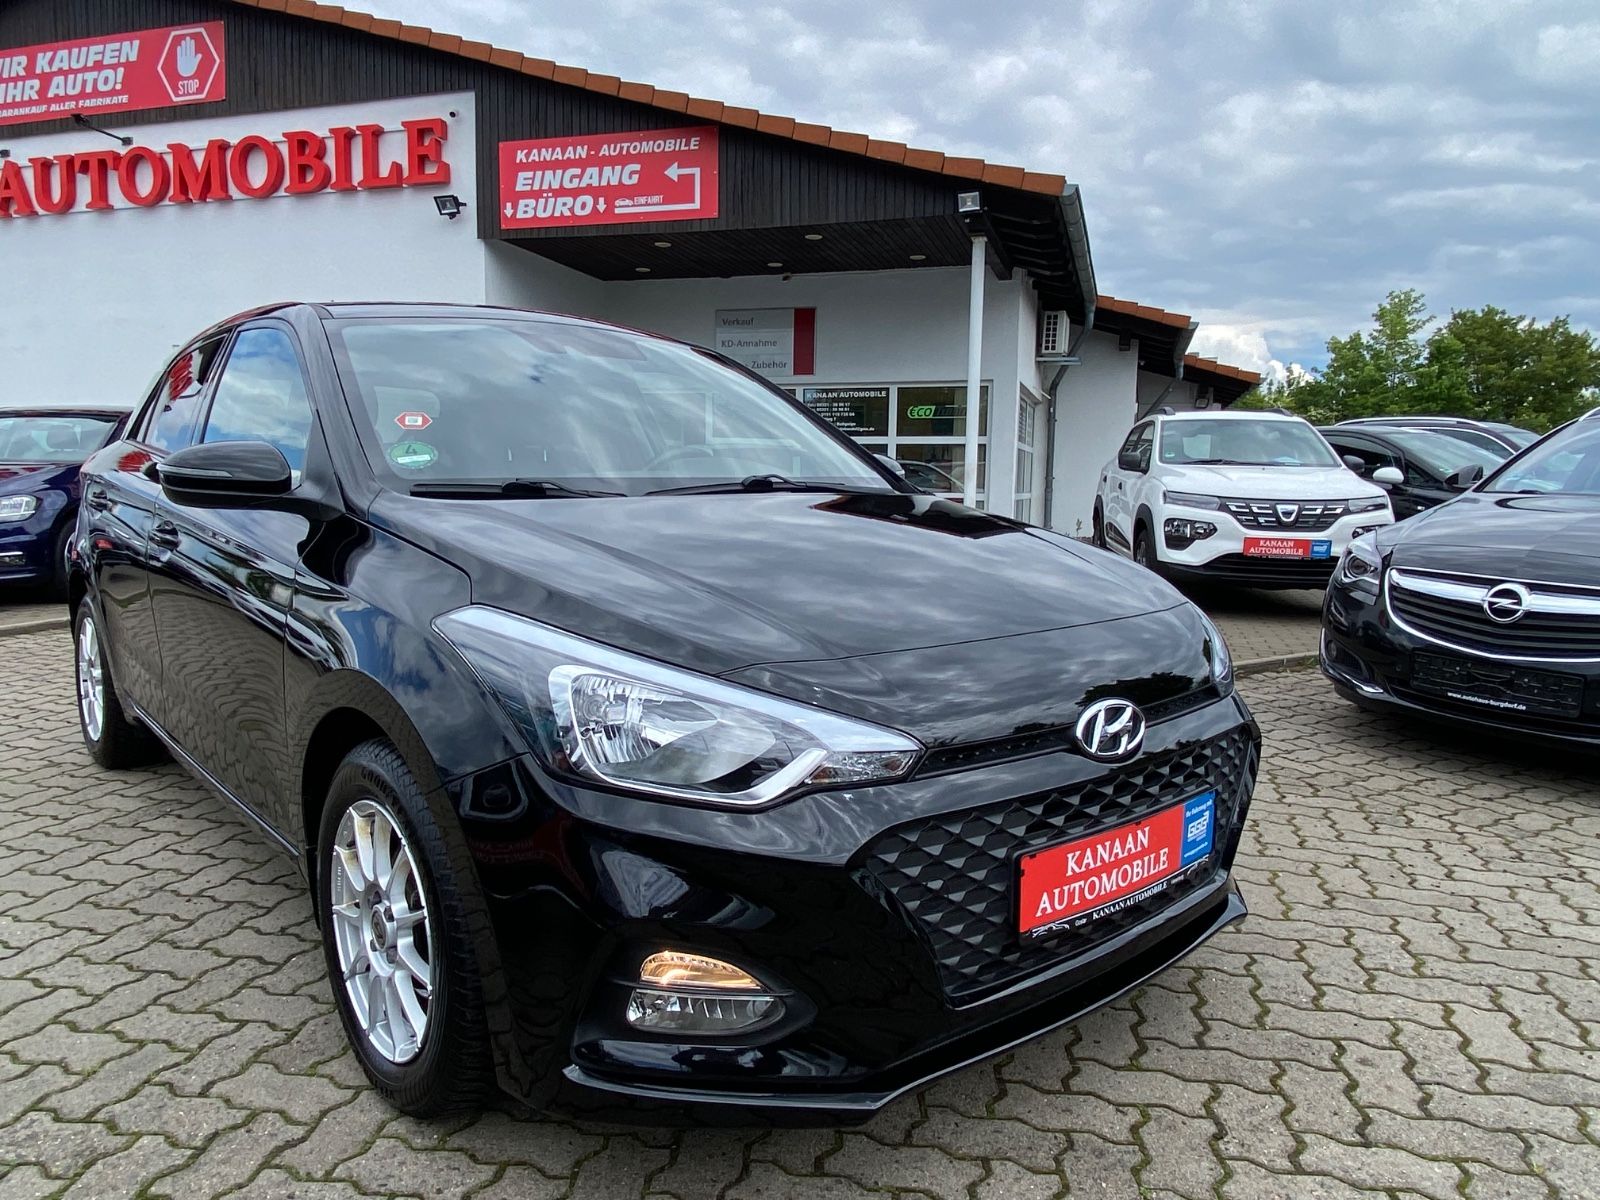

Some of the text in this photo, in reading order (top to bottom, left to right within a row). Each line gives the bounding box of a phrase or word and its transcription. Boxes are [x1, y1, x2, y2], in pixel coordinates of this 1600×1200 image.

[0, 40, 140, 78] IR KAUFEN
[0, 66, 125, 103] IHR AUTO!
[178, 79, 200, 95] STOP
[49, 101, 76, 112] ALLER
[78, 95, 129, 108] FABRIKATE
[515, 145, 588, 163] KANAAN
[598, 137, 701, 157] AUTOMOBILE
[0, 117, 450, 219] AUTOMOBILE
[515, 164, 641, 191] EINGANG
[516, 193, 594, 219] BÜRO
[633, 195, 664, 205] EINFAHRT
[721, 317, 754, 326] Verkauf
[721, 340, 777, 348] KD-Annahme
[1249, 547, 1304, 555] AUTOMOBILE
[1066, 827, 1150, 877] KANAAN
[1035, 848, 1169, 918] AUTOMOBILE
[1092, 902, 1126, 920] KANAAN
[1124, 882, 1168, 908] AUTOMOBILE
